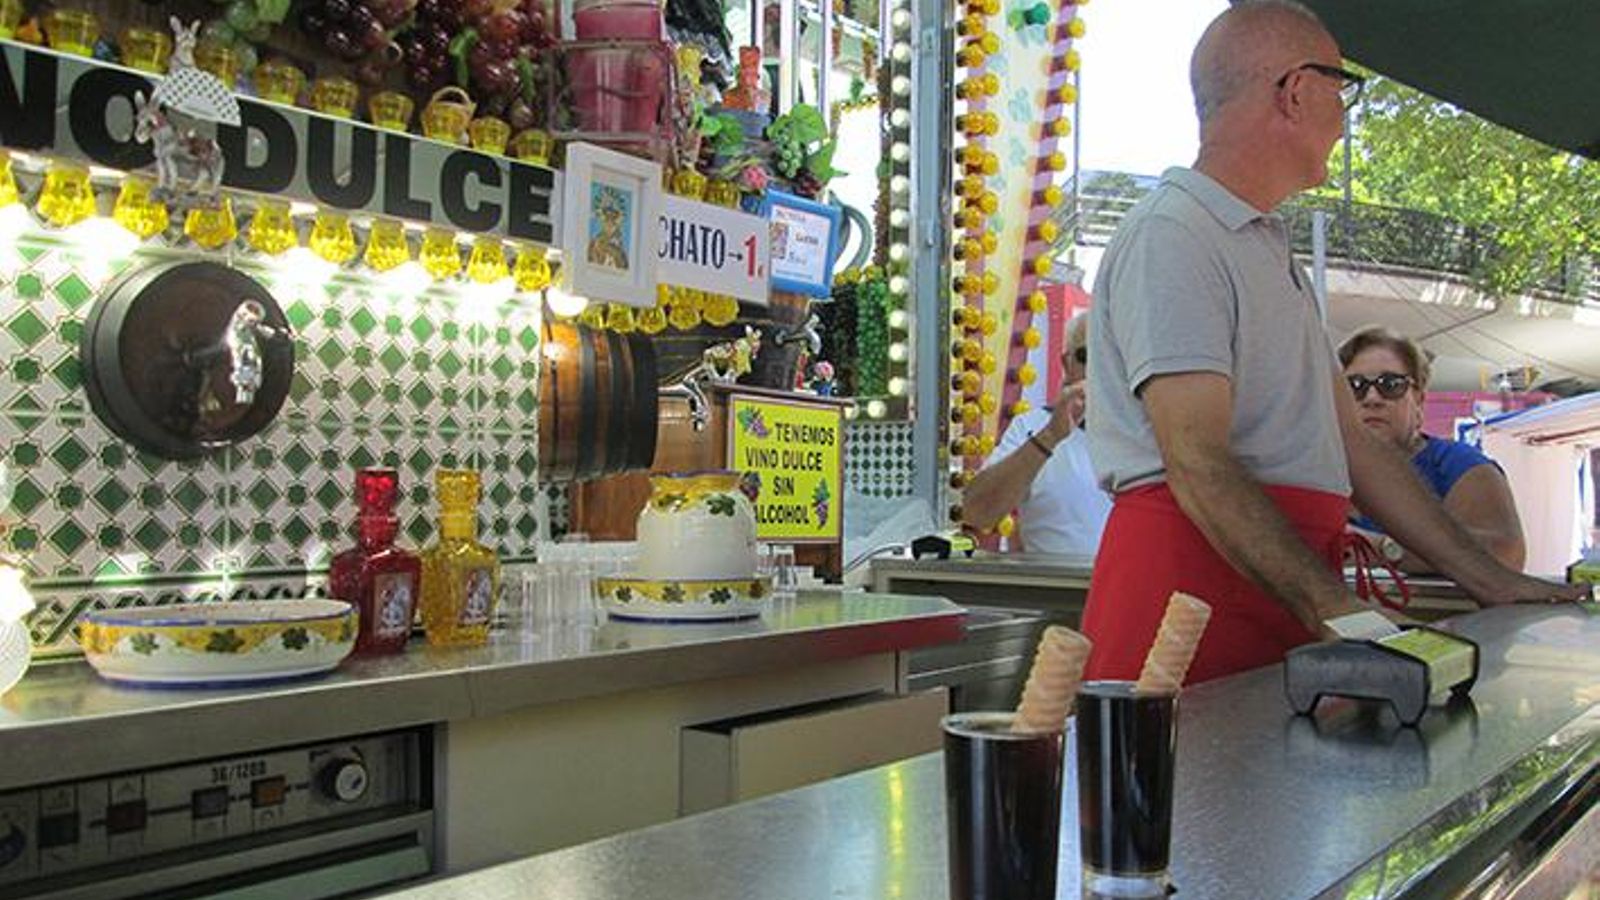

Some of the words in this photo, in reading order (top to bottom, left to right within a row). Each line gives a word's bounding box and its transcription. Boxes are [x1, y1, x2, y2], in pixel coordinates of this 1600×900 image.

[215, 96, 555, 244] DULCE
[774, 422, 835, 447] TENEMOS
[746, 447, 779, 468] VINO
[782, 449, 823, 472] DULCE
[773, 475, 795, 497] SIN
